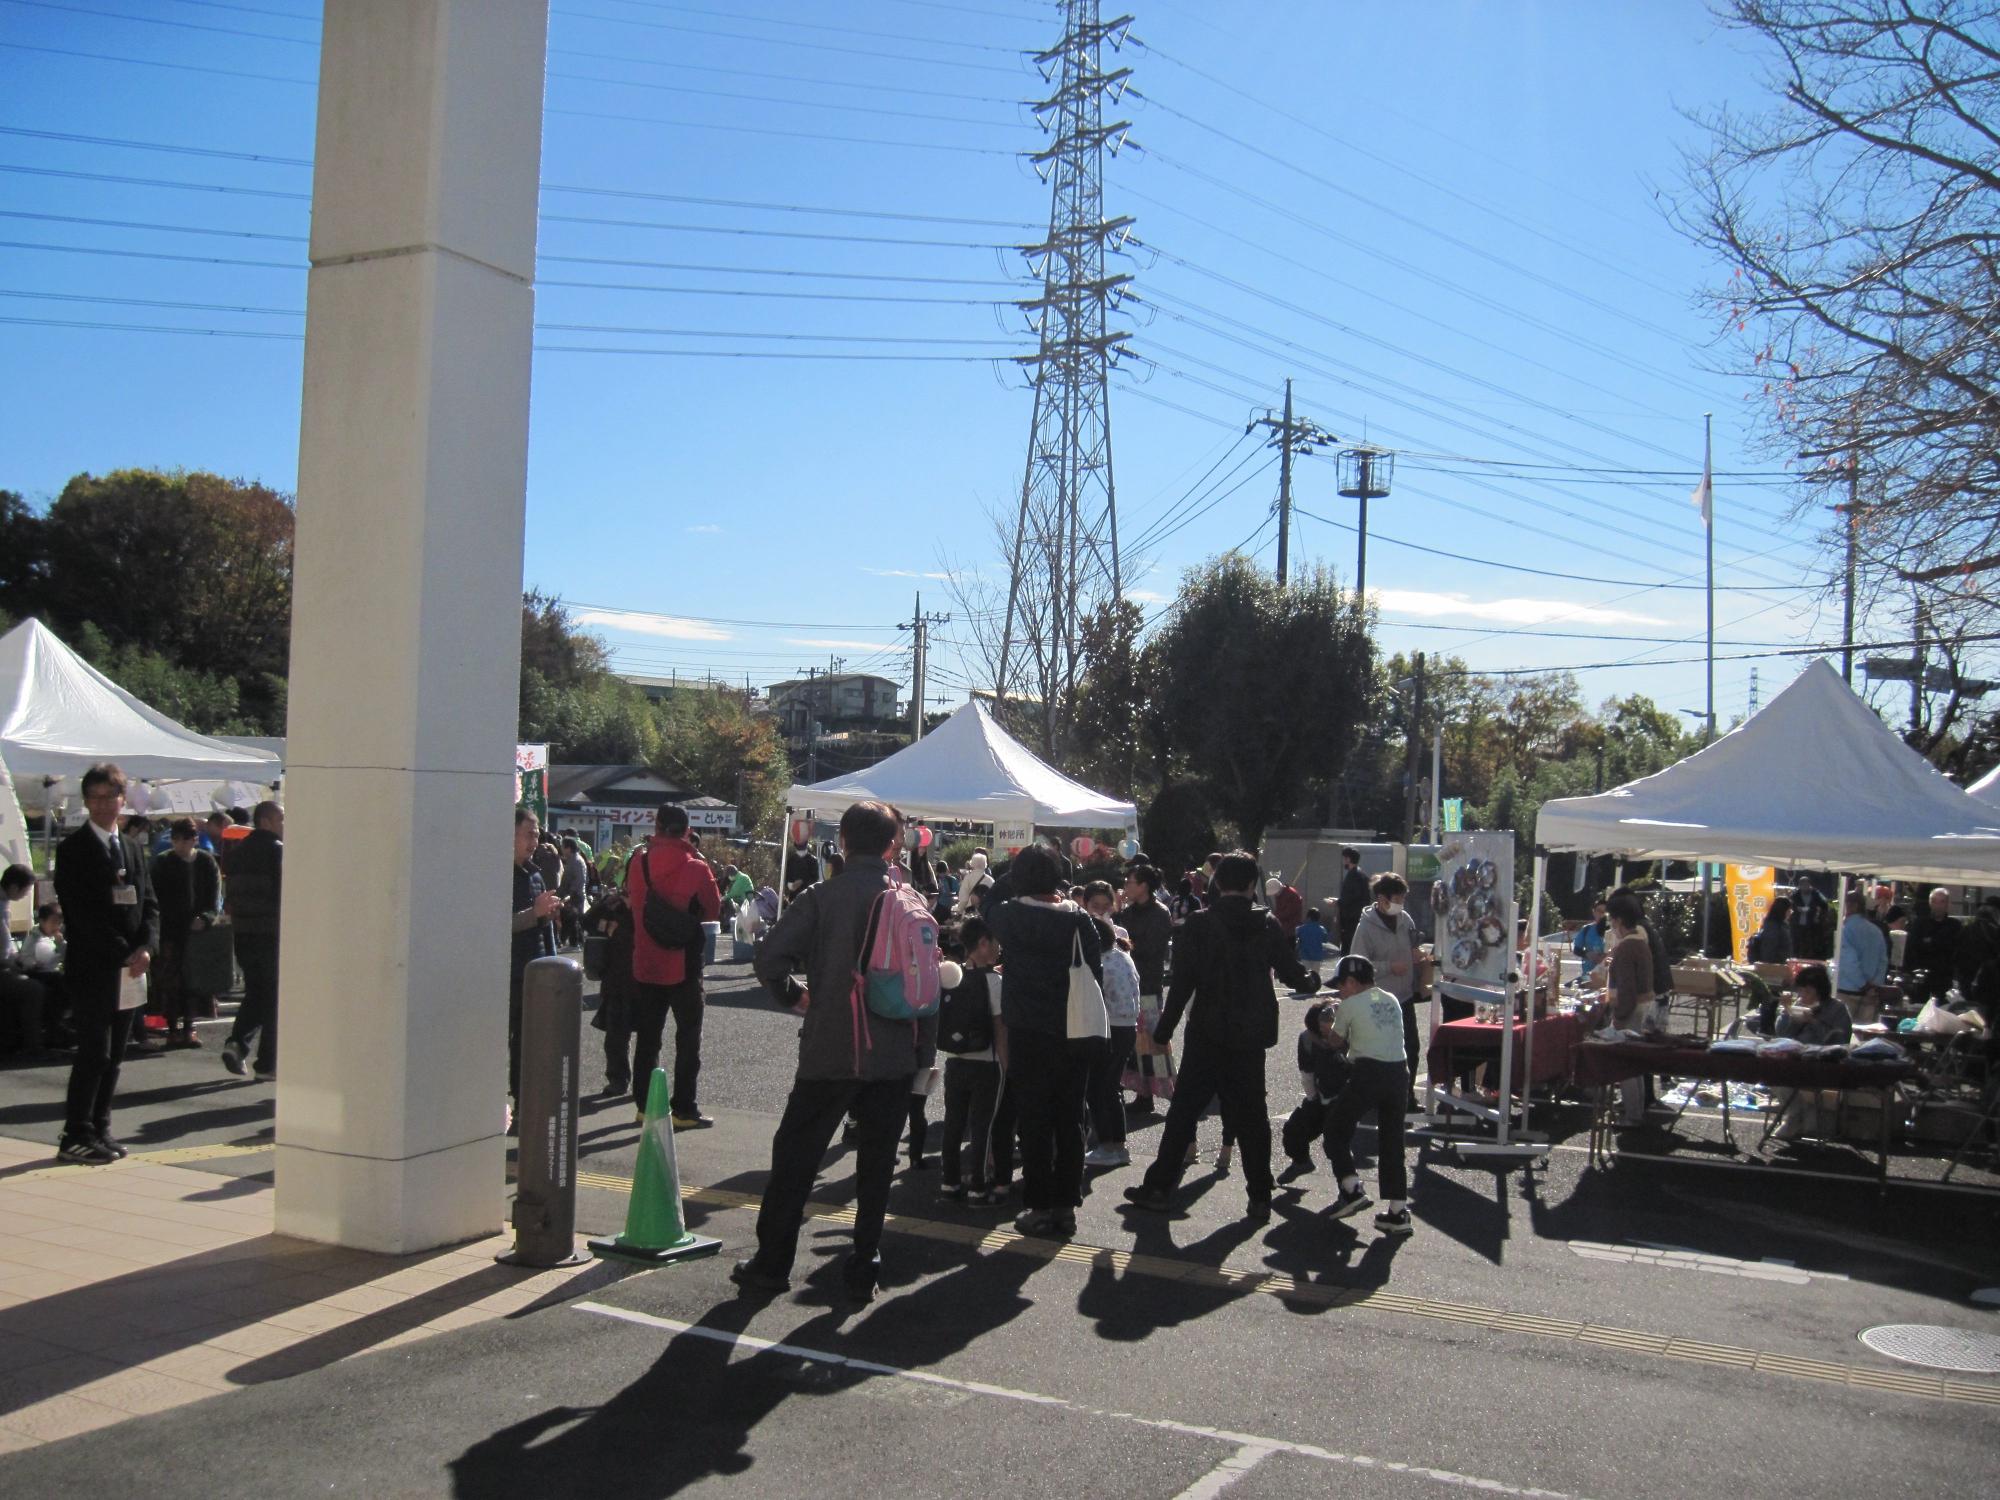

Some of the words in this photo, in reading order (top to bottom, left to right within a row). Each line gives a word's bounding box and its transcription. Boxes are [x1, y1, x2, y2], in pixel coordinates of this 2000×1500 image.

[608, 808, 701, 825] コインラー
